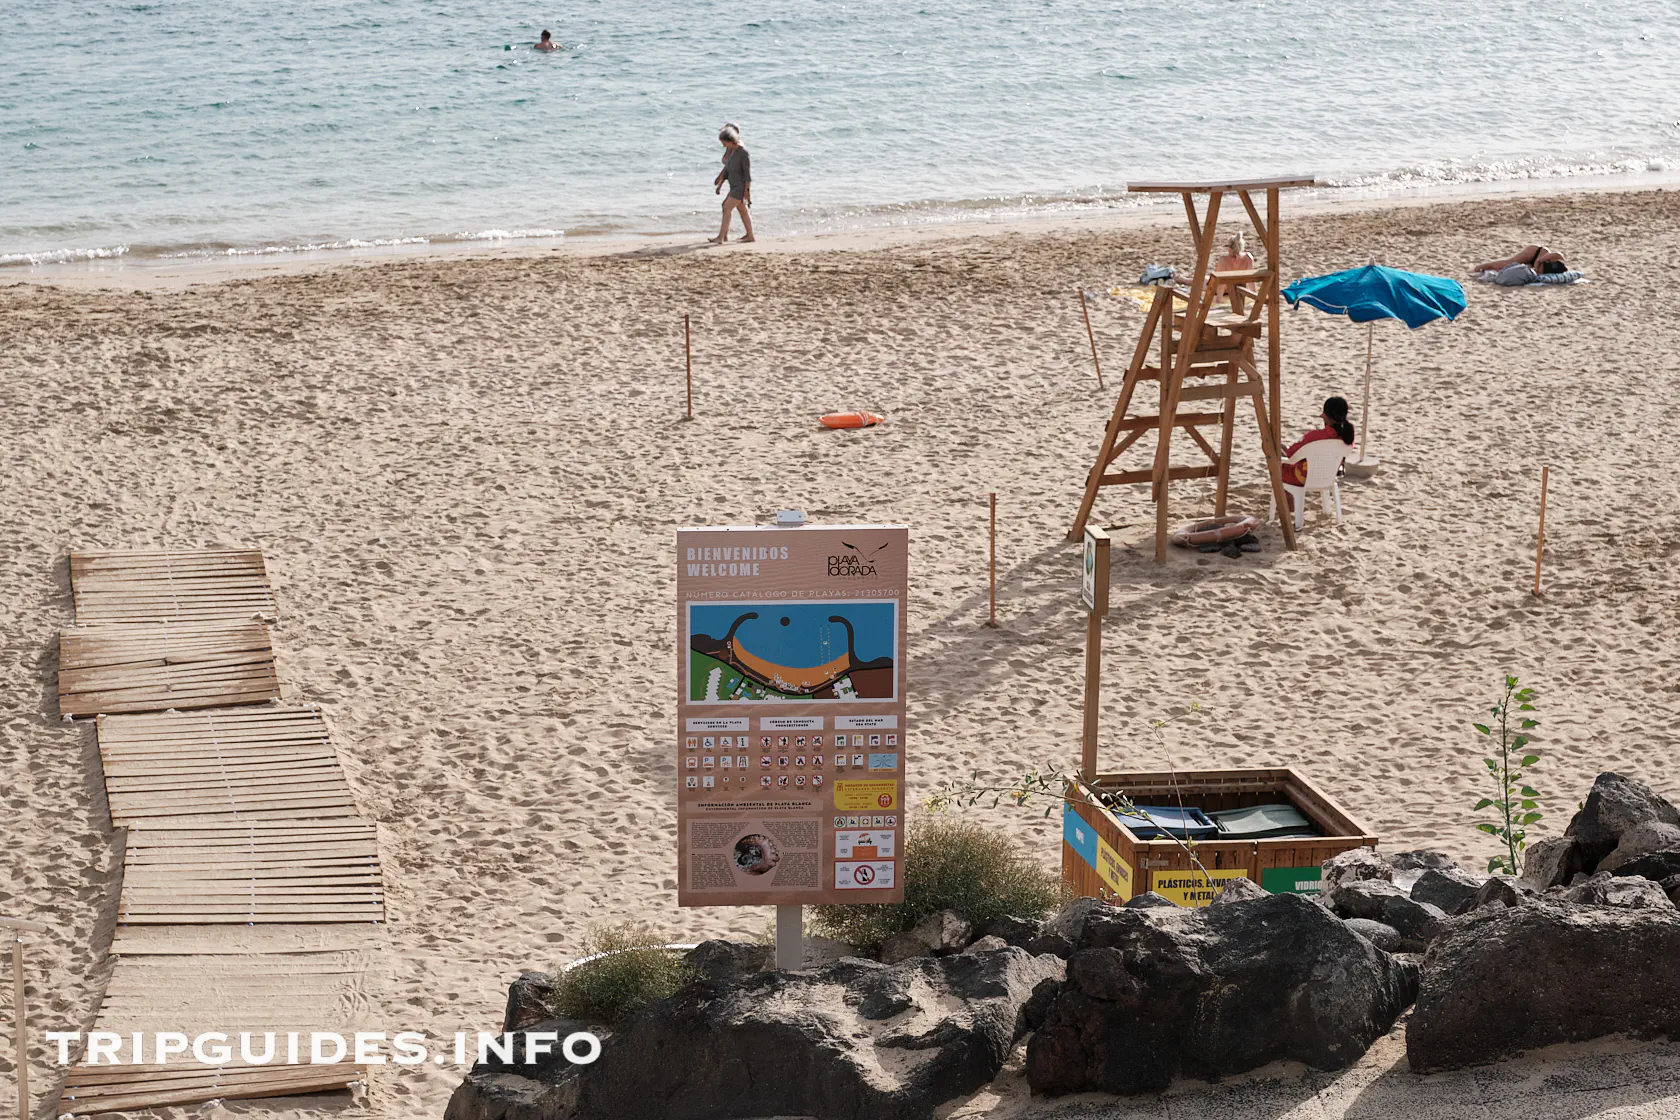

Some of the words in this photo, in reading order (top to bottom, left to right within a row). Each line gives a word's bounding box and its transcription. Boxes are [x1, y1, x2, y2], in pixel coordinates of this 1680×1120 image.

[687, 546, 789, 561] BIENVENIDOS
[687, 563, 760, 577] WELCOME
[809, 589, 850, 597] PLAYAS:
[855, 589, 900, 597] 21305700
[1183, 892, 1189, 900] Y
